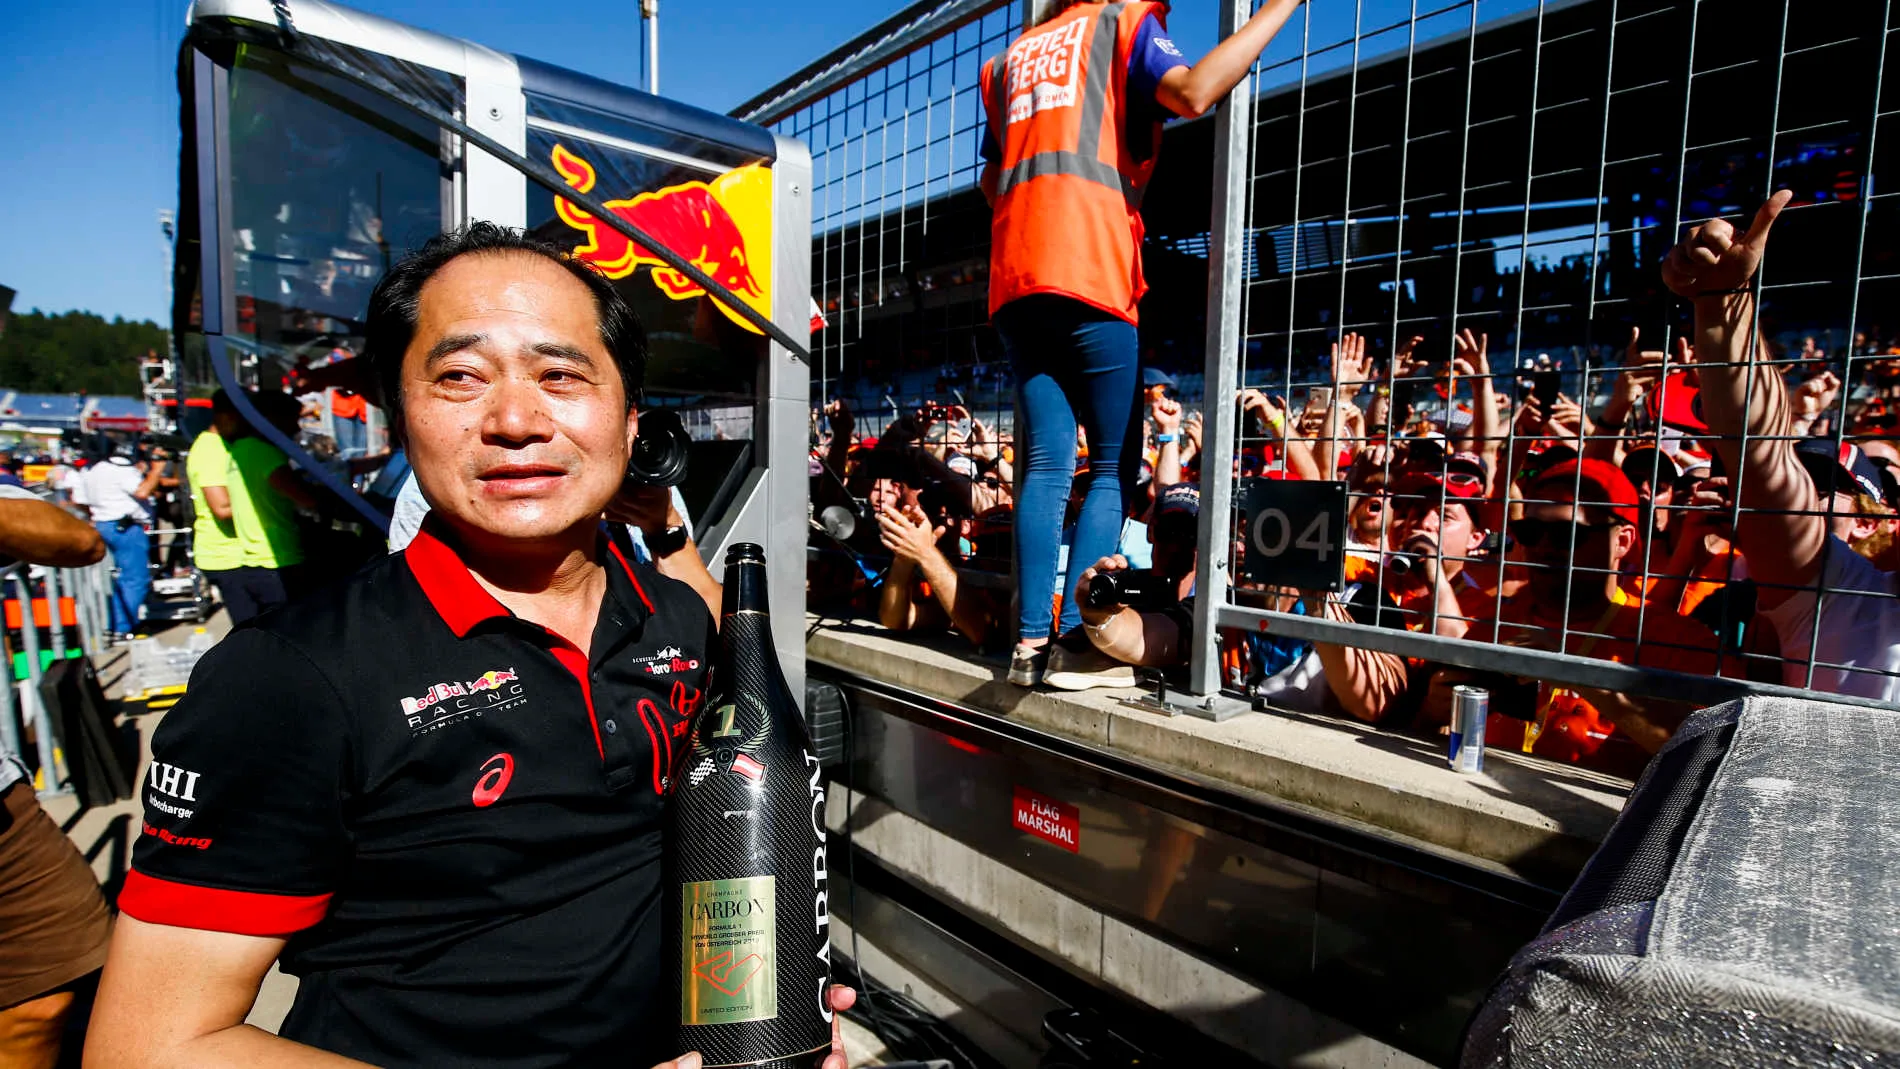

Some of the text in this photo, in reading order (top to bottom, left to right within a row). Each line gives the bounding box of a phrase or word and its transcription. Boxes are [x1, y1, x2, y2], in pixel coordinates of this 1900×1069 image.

[1008, 16, 1089, 66] SPIEL
[1009, 47, 1068, 93] BERG
[1252, 508, 1334, 562] 04
[648, 661, 670, 675] Toro
[408, 683, 523, 728] RACNG
[712, 704, 741, 738] 1
[150, 761, 201, 802] IHI
[1018, 810, 1074, 845] MARSHAL
[1031, 799, 1060, 821] FLAG
[689, 898, 764, 920] CARBON
